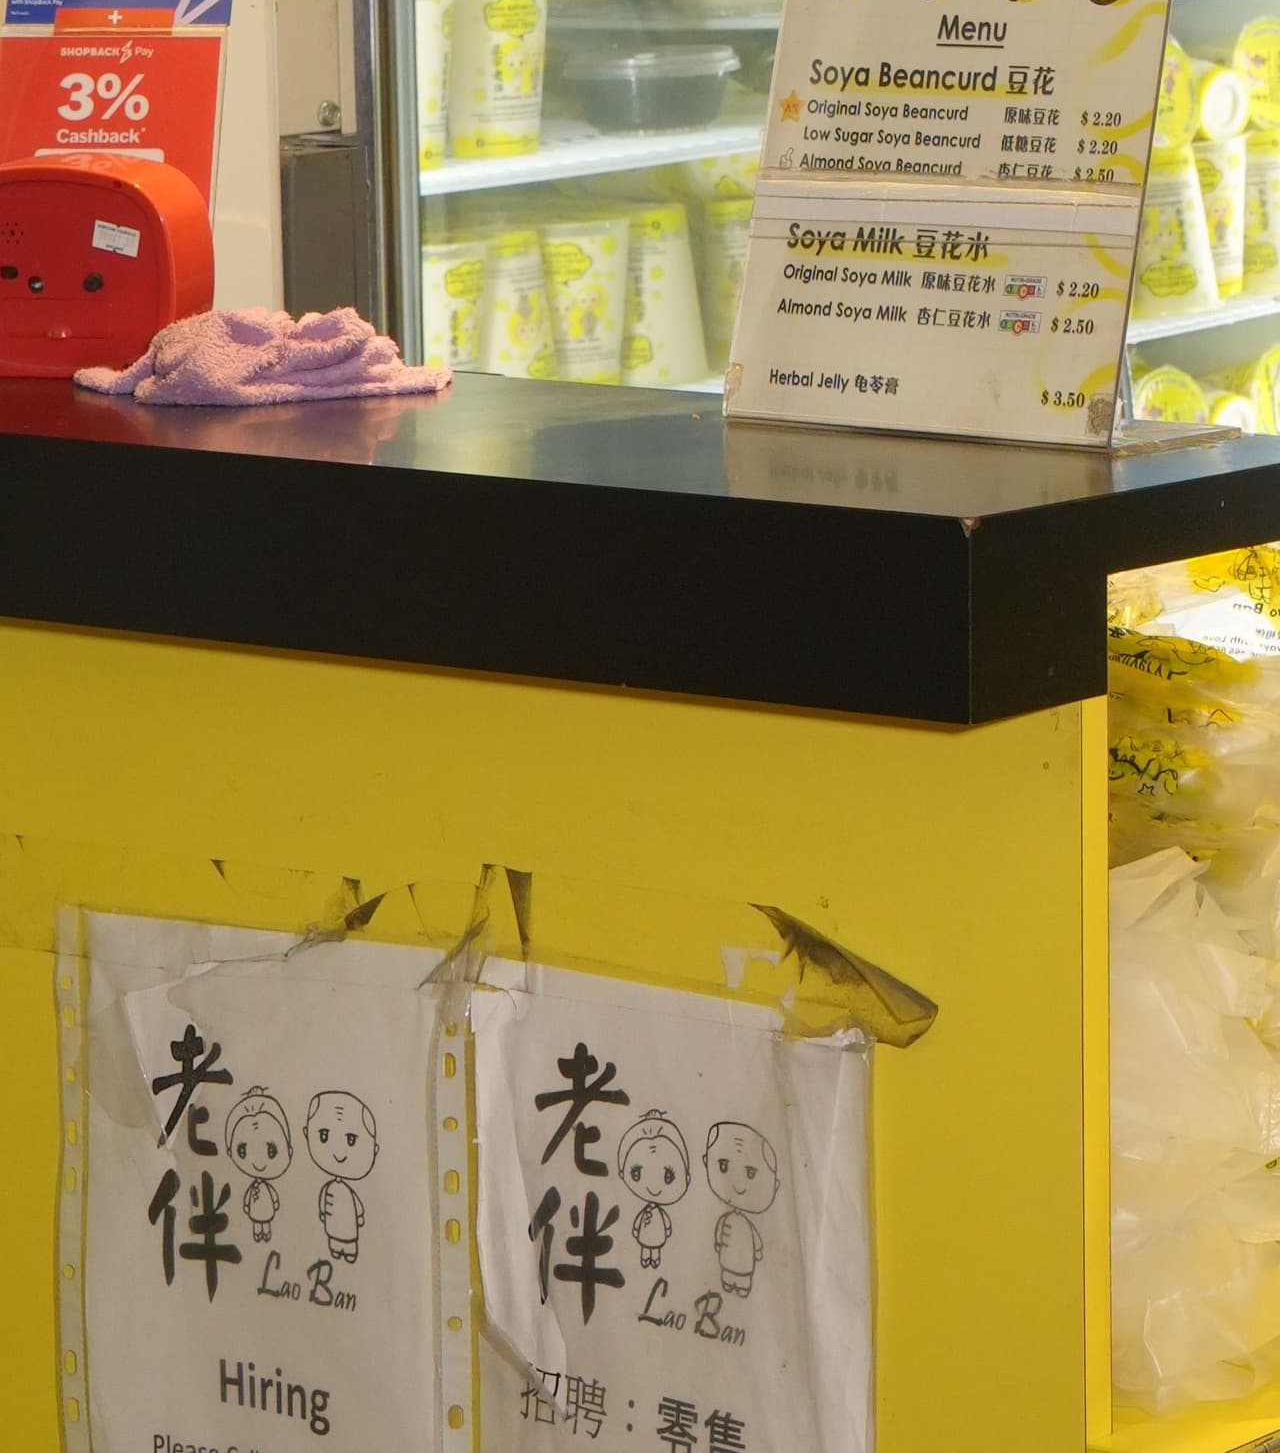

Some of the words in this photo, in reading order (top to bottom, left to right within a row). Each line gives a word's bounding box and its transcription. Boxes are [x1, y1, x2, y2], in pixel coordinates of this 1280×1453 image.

[936, 13, 1008, 42] Menu
[60, 47, 120, 57] SHOPBACK
[135, 47, 154, 58] Pay
[809, 58, 869, 92] Soya
[878, 61, 997, 92] Beancurd
[1005, 65, 1056, 95] 豆花
[58, 72, 150, 122] 3%
[807, 99, 861, 118] Original
[864, 102, 898, 121] Soya
[903, 103, 968, 121] Beancurd
[804, 126, 830, 142] Low
[834, 127, 872, 147] Sugar
[877, 129, 911, 148] Soya
[915, 131, 981, 149] Beancurd
[800, 153, 854, 172] Almond
[896, 158, 962, 176] Beancurd
[787, 222, 846, 256] Soya
[853, 226, 903, 255] Milk
[912, 228, 991, 262] 豆花水
[783, 264, 838, 283] Original
[841, 267, 876, 286] Soya
[881, 269, 912, 287] Milk
[777, 298, 832, 317] Almond
[836, 302, 871, 322] Soya
[876, 305, 907, 323] Milk
[769, 368, 813, 388] Herbal
[817, 372, 849, 394] Jelly
[148, 1024, 243, 1303] 老伴
[528, 1042, 630, 1326] 老伴
[257, 1250, 301, 1301] Lao
[306, 1258, 356, 1311] Ban
[638, 1277, 687, 1331] Lao
[694, 1290, 745, 1346] Ban
[219, 1358, 330, 1436] Hiring
